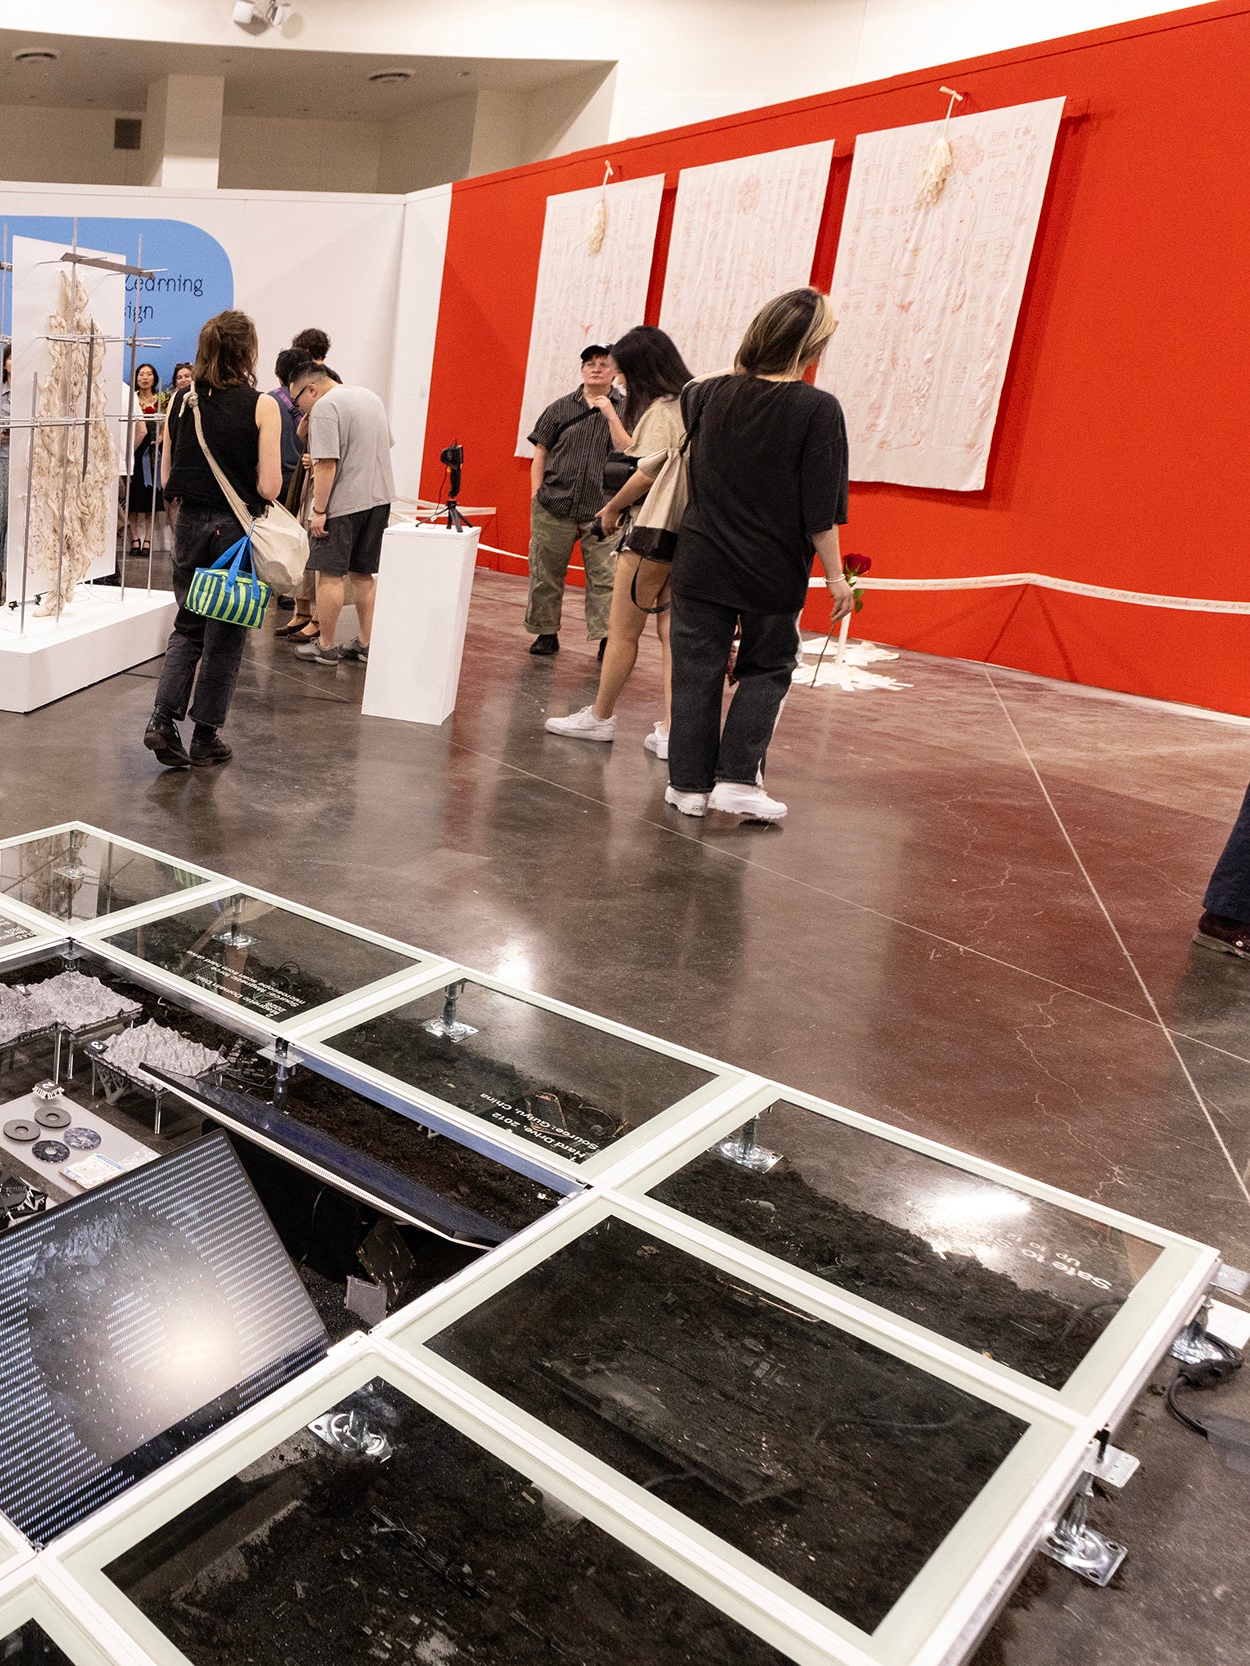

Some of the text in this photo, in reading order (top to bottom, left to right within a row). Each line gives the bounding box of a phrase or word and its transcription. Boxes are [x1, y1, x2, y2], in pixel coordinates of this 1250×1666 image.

[212, 982, 243, 999] Domain
[230, 975, 268, 993] Magnetic
[257, 982, 306, 1005] microscope
[267, 990, 300, 1008] Source:
[242, 996, 281, 1016] Magnetic
[91, 1041, 103, 1050] 3
[480, 1093, 512, 1111] China
[491, 1111, 586, 1159] Hard Drive, 2012
[551, 1126, 599, 1150] Source:
[1029, 1241, 1046, 1252] to
[1021, 1248, 1112, 1290] Safe to
